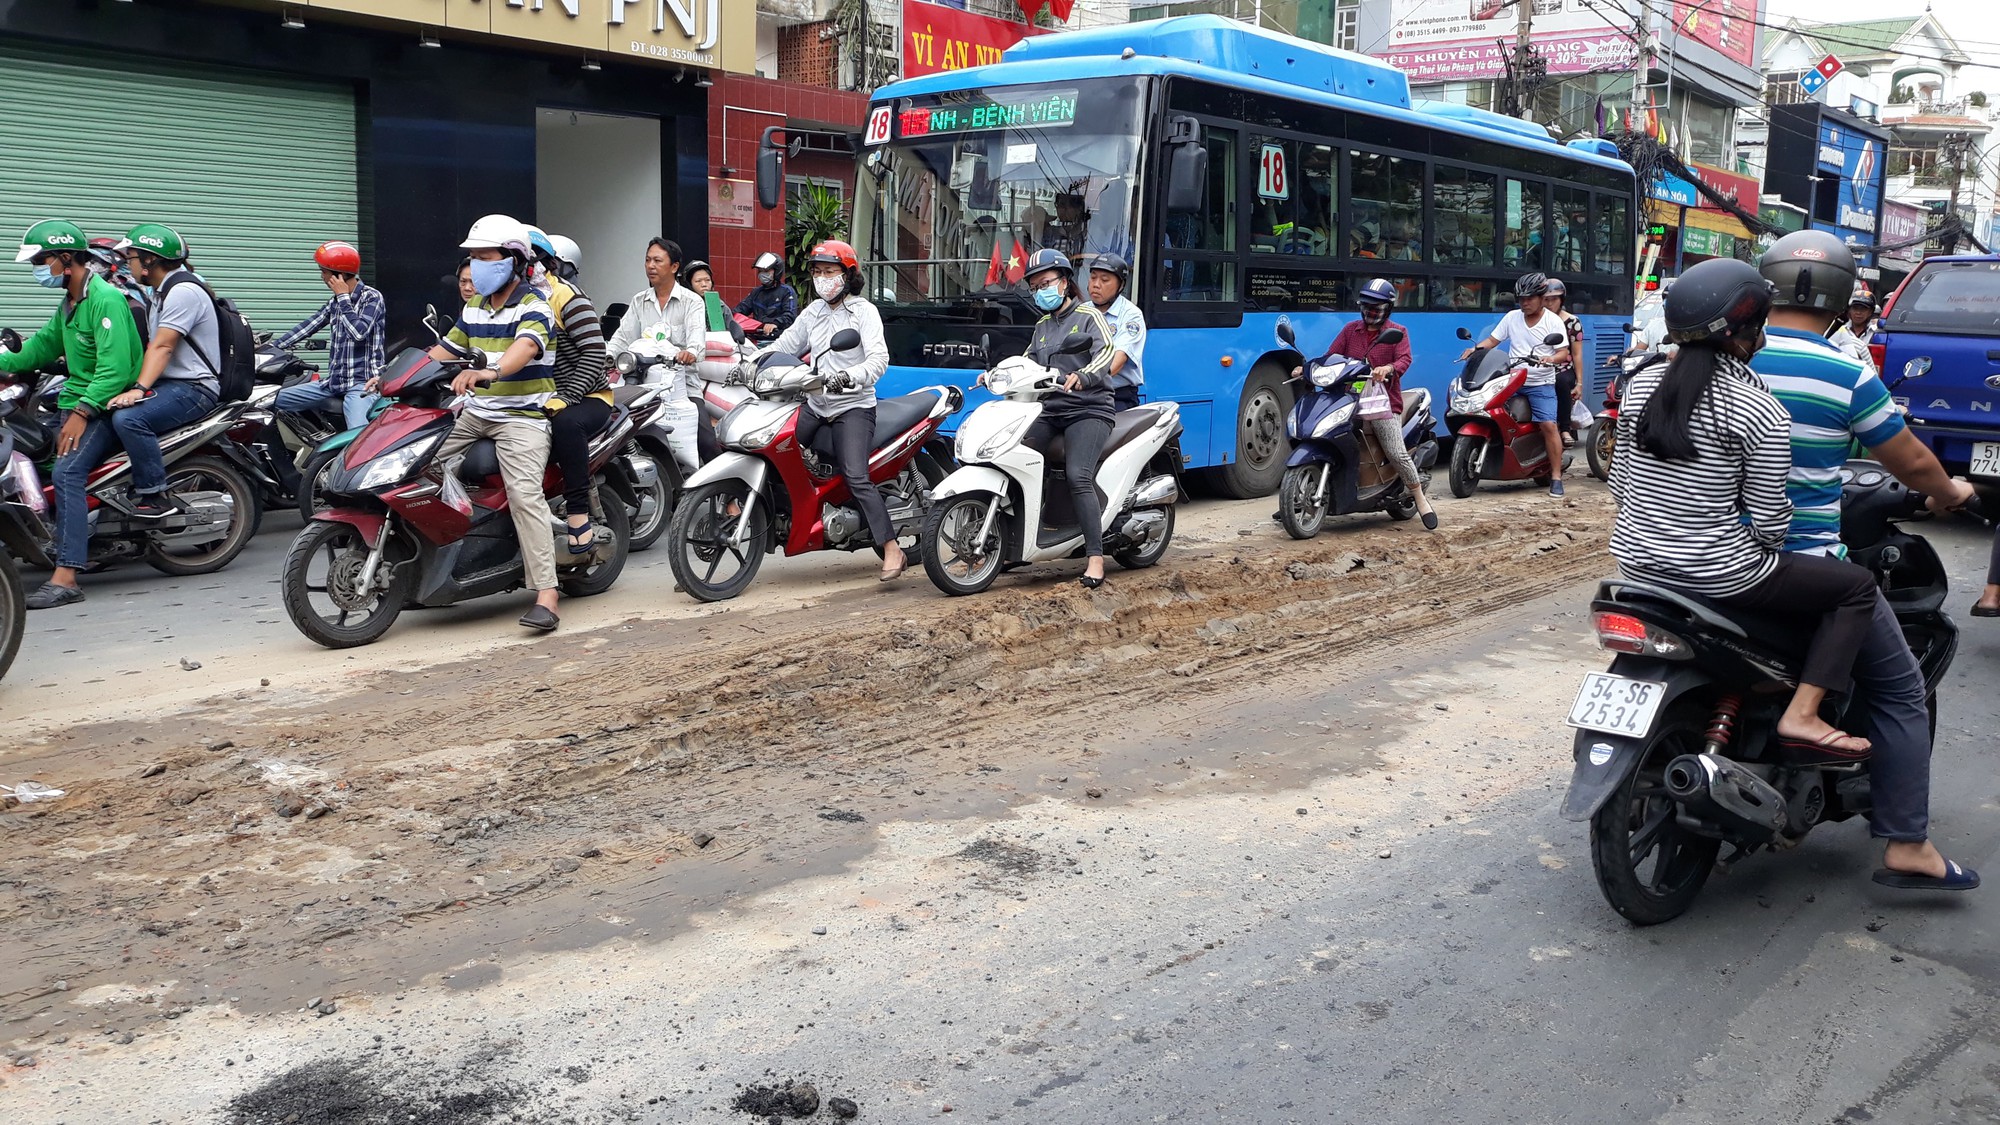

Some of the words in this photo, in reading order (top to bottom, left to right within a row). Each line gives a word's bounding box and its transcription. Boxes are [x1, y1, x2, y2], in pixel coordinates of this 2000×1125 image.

[1405, 15, 1467, 26] www.vietphone.com.vn
[1404, 30, 1416, 38] (08)
[1449, 23, 1486, 33] 093.7799805
[942, 38, 969, 69] AN
[1555, 51, 1578, 64] 30%
[870, 111, 890, 140] 18
[1263, 150, 1284, 194] 18
[47, 234, 75, 245] Grab
[138, 235, 164, 249] Grab
[405, 499, 432, 509] HONDA
[1579, 701, 1640, 732] 2534
